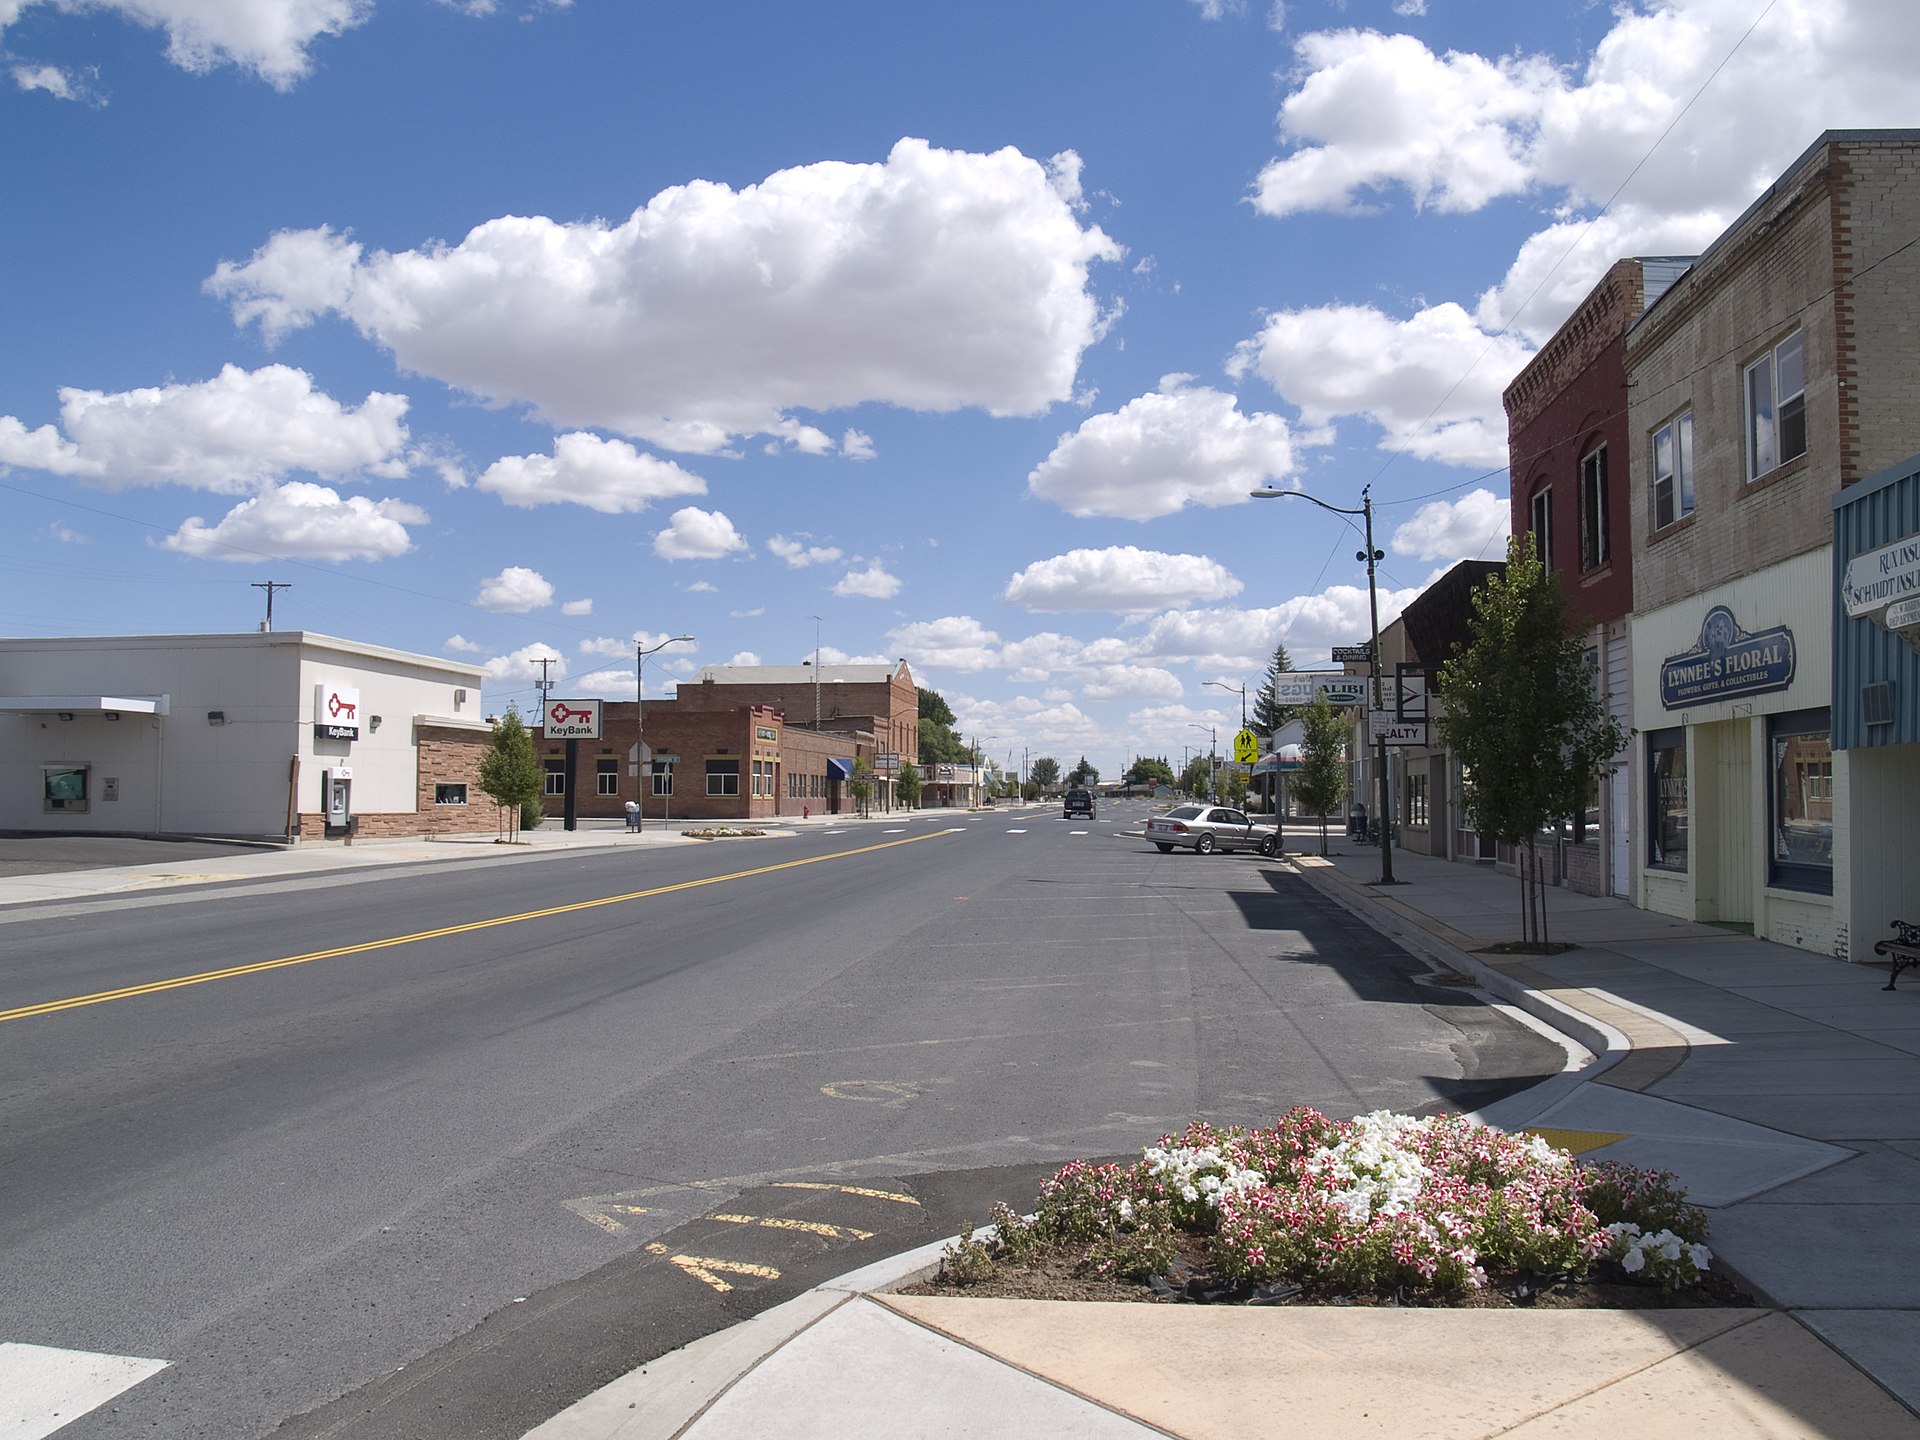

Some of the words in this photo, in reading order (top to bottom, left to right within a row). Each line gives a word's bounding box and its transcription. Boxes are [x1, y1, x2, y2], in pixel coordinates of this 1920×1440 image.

[1880, 550, 1898, 574] RUX
[1853, 577, 1896, 606] SCHMIDT
[1668, 659, 1722, 687] LYNNEE'S
[1725, 645, 1782, 674] FLORAL
[1725, 671, 1768, 686] COLLECTIBLES
[1321, 684, 1364, 695] ALIBI
[328, 726, 354, 738] KeyBank
[550, 725, 593, 736] KeyBank
